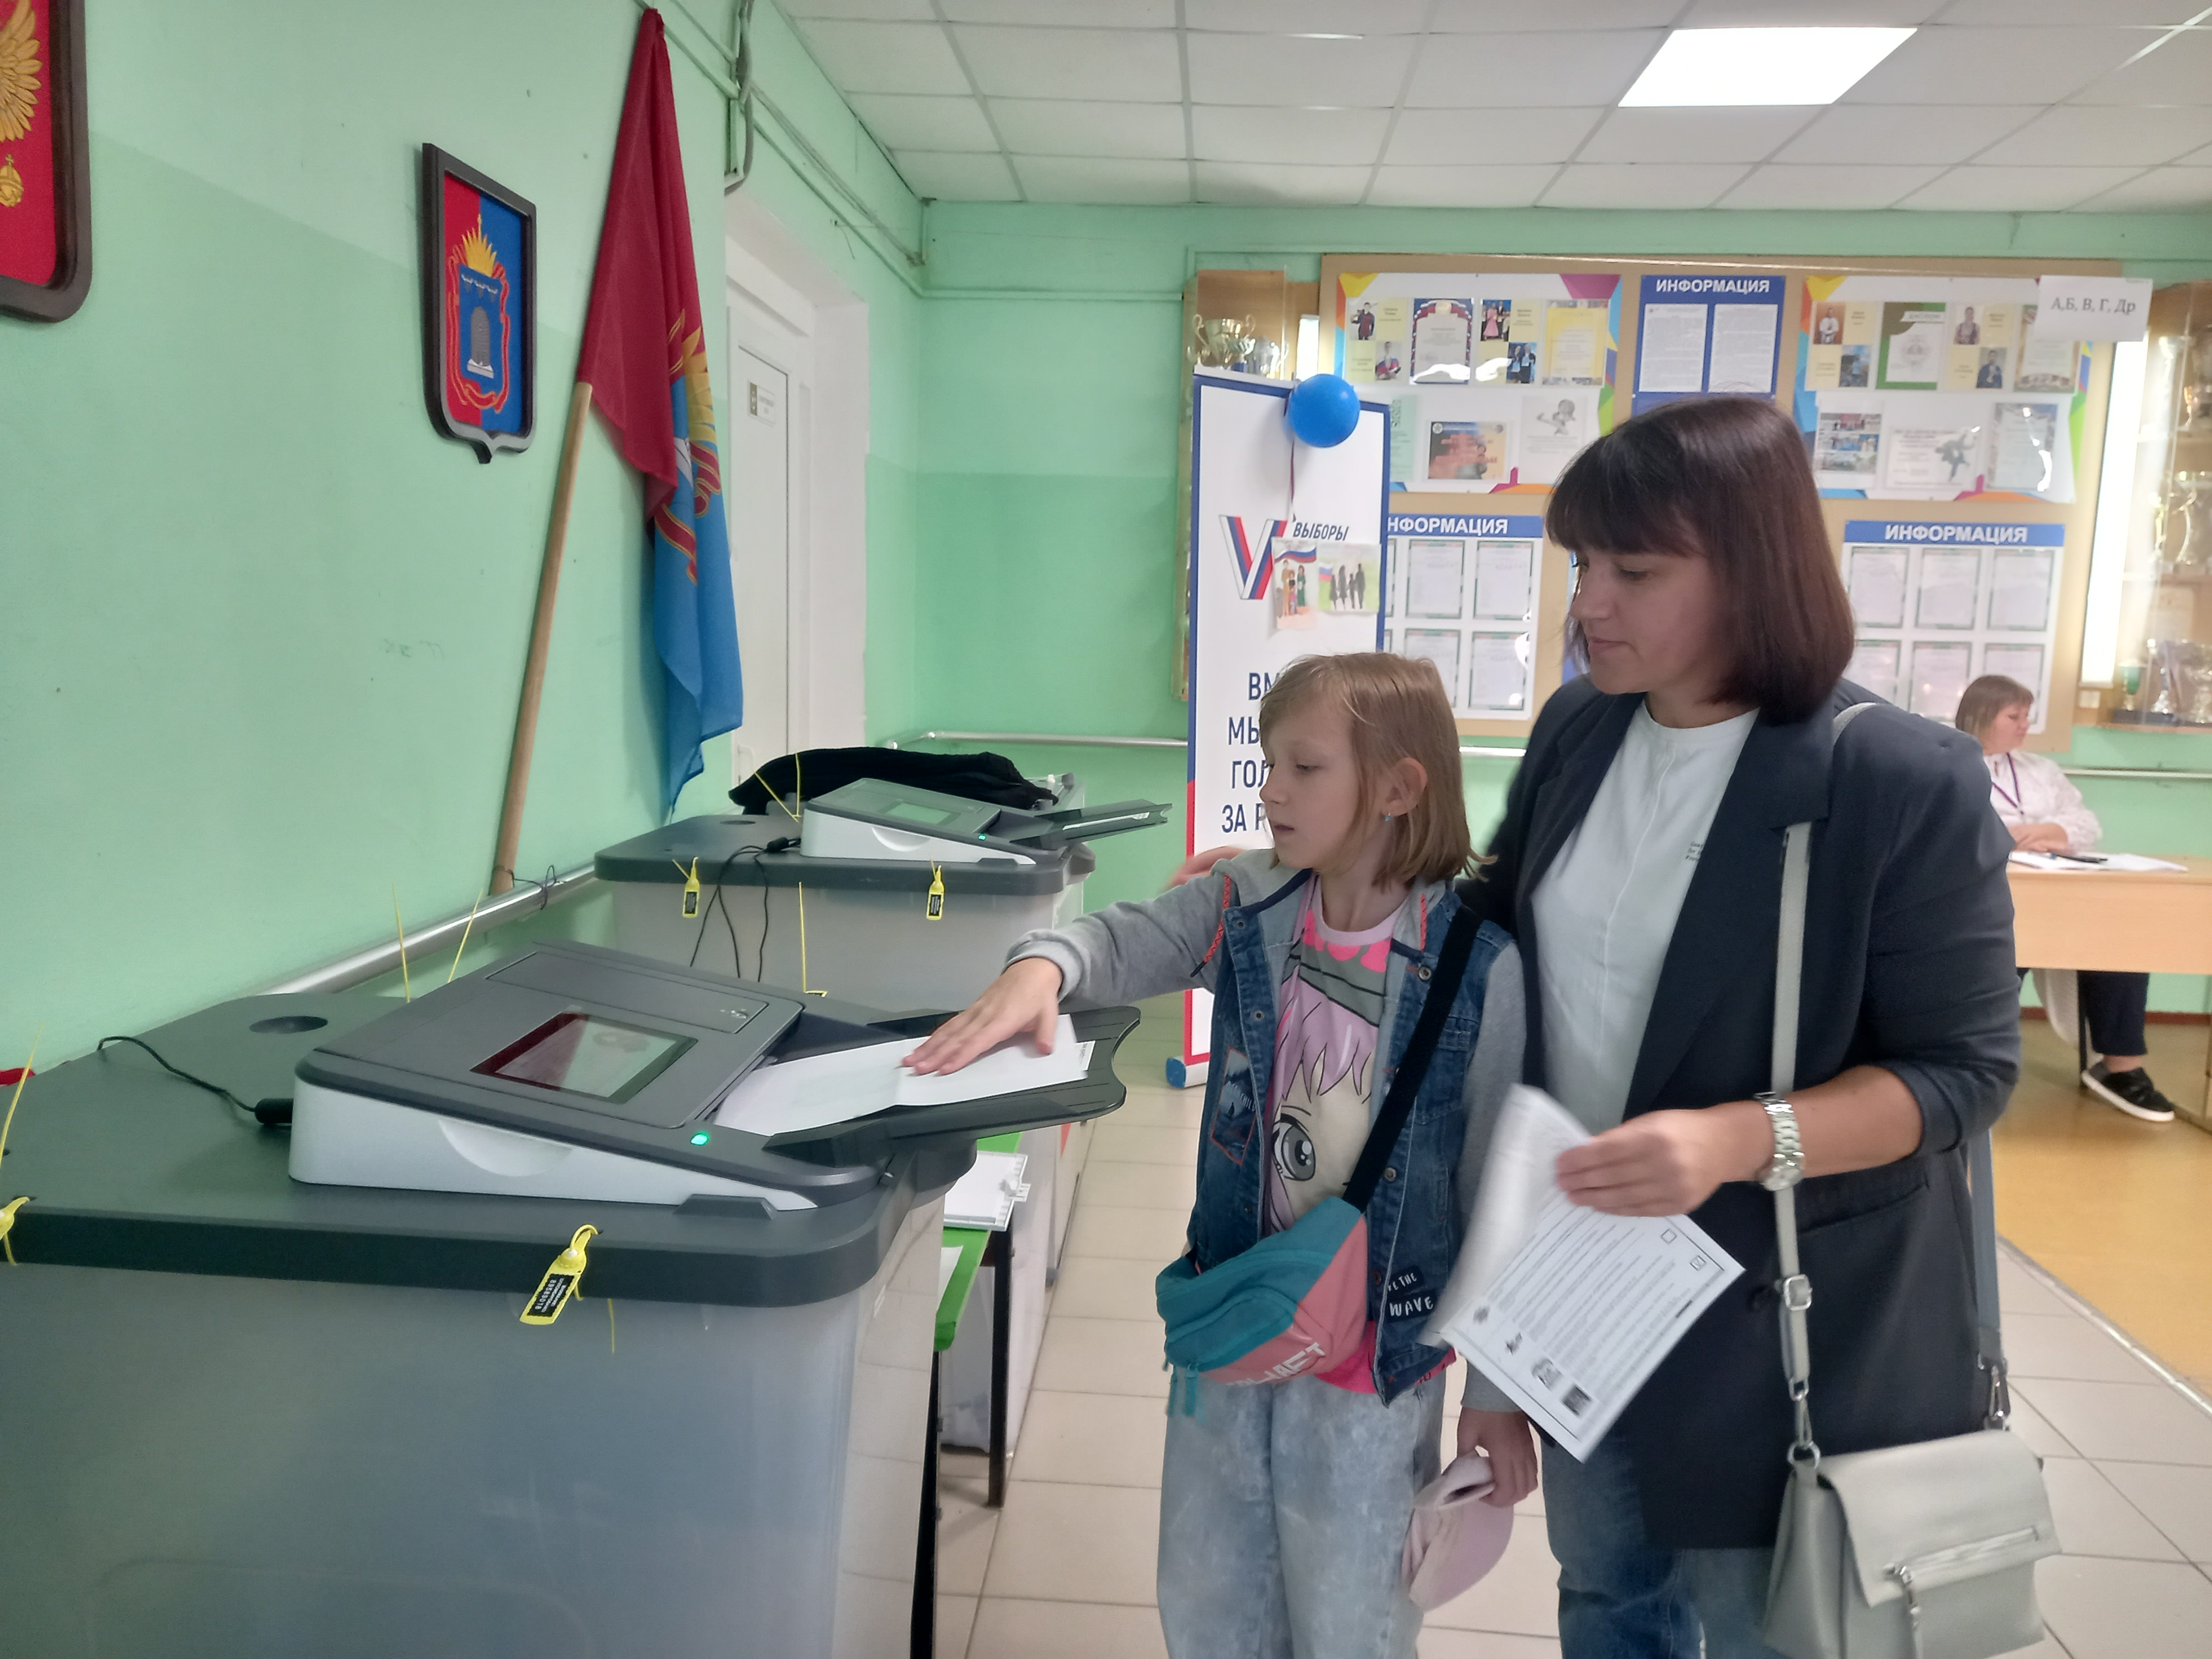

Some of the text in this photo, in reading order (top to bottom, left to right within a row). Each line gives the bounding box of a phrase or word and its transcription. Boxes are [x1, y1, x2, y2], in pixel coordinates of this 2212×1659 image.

[1656, 279, 1770, 295] ИНФОРМАЦИЯ
[1293, 522, 1349, 541] ВЫБОРЫ
[1387, 517, 1508, 536] НФОРМАЦИЯ
[1885, 524, 2028, 545] ИНФОРМАЦИЯ
[1221, 804, 1246, 833] ЗА
[1399, 1273, 1417, 1287] THE
[1390, 1296, 1433, 1316] WAVE
